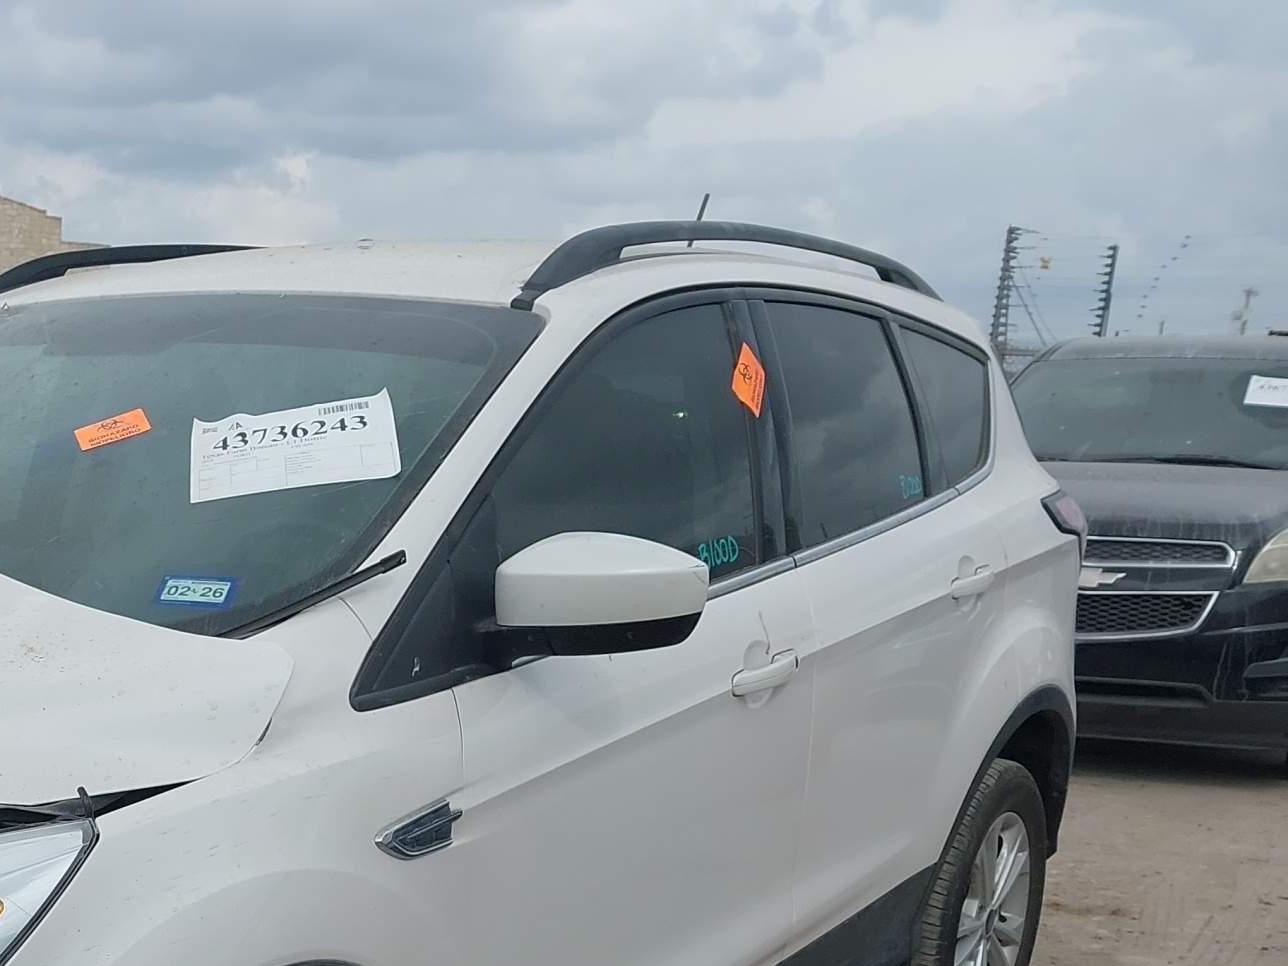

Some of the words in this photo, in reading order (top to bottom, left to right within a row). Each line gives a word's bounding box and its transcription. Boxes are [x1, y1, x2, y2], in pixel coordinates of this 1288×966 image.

[213, 415, 368, 450] 43736243
[167, 585, 190, 596] 02
[199, 586, 225, 598] 26
